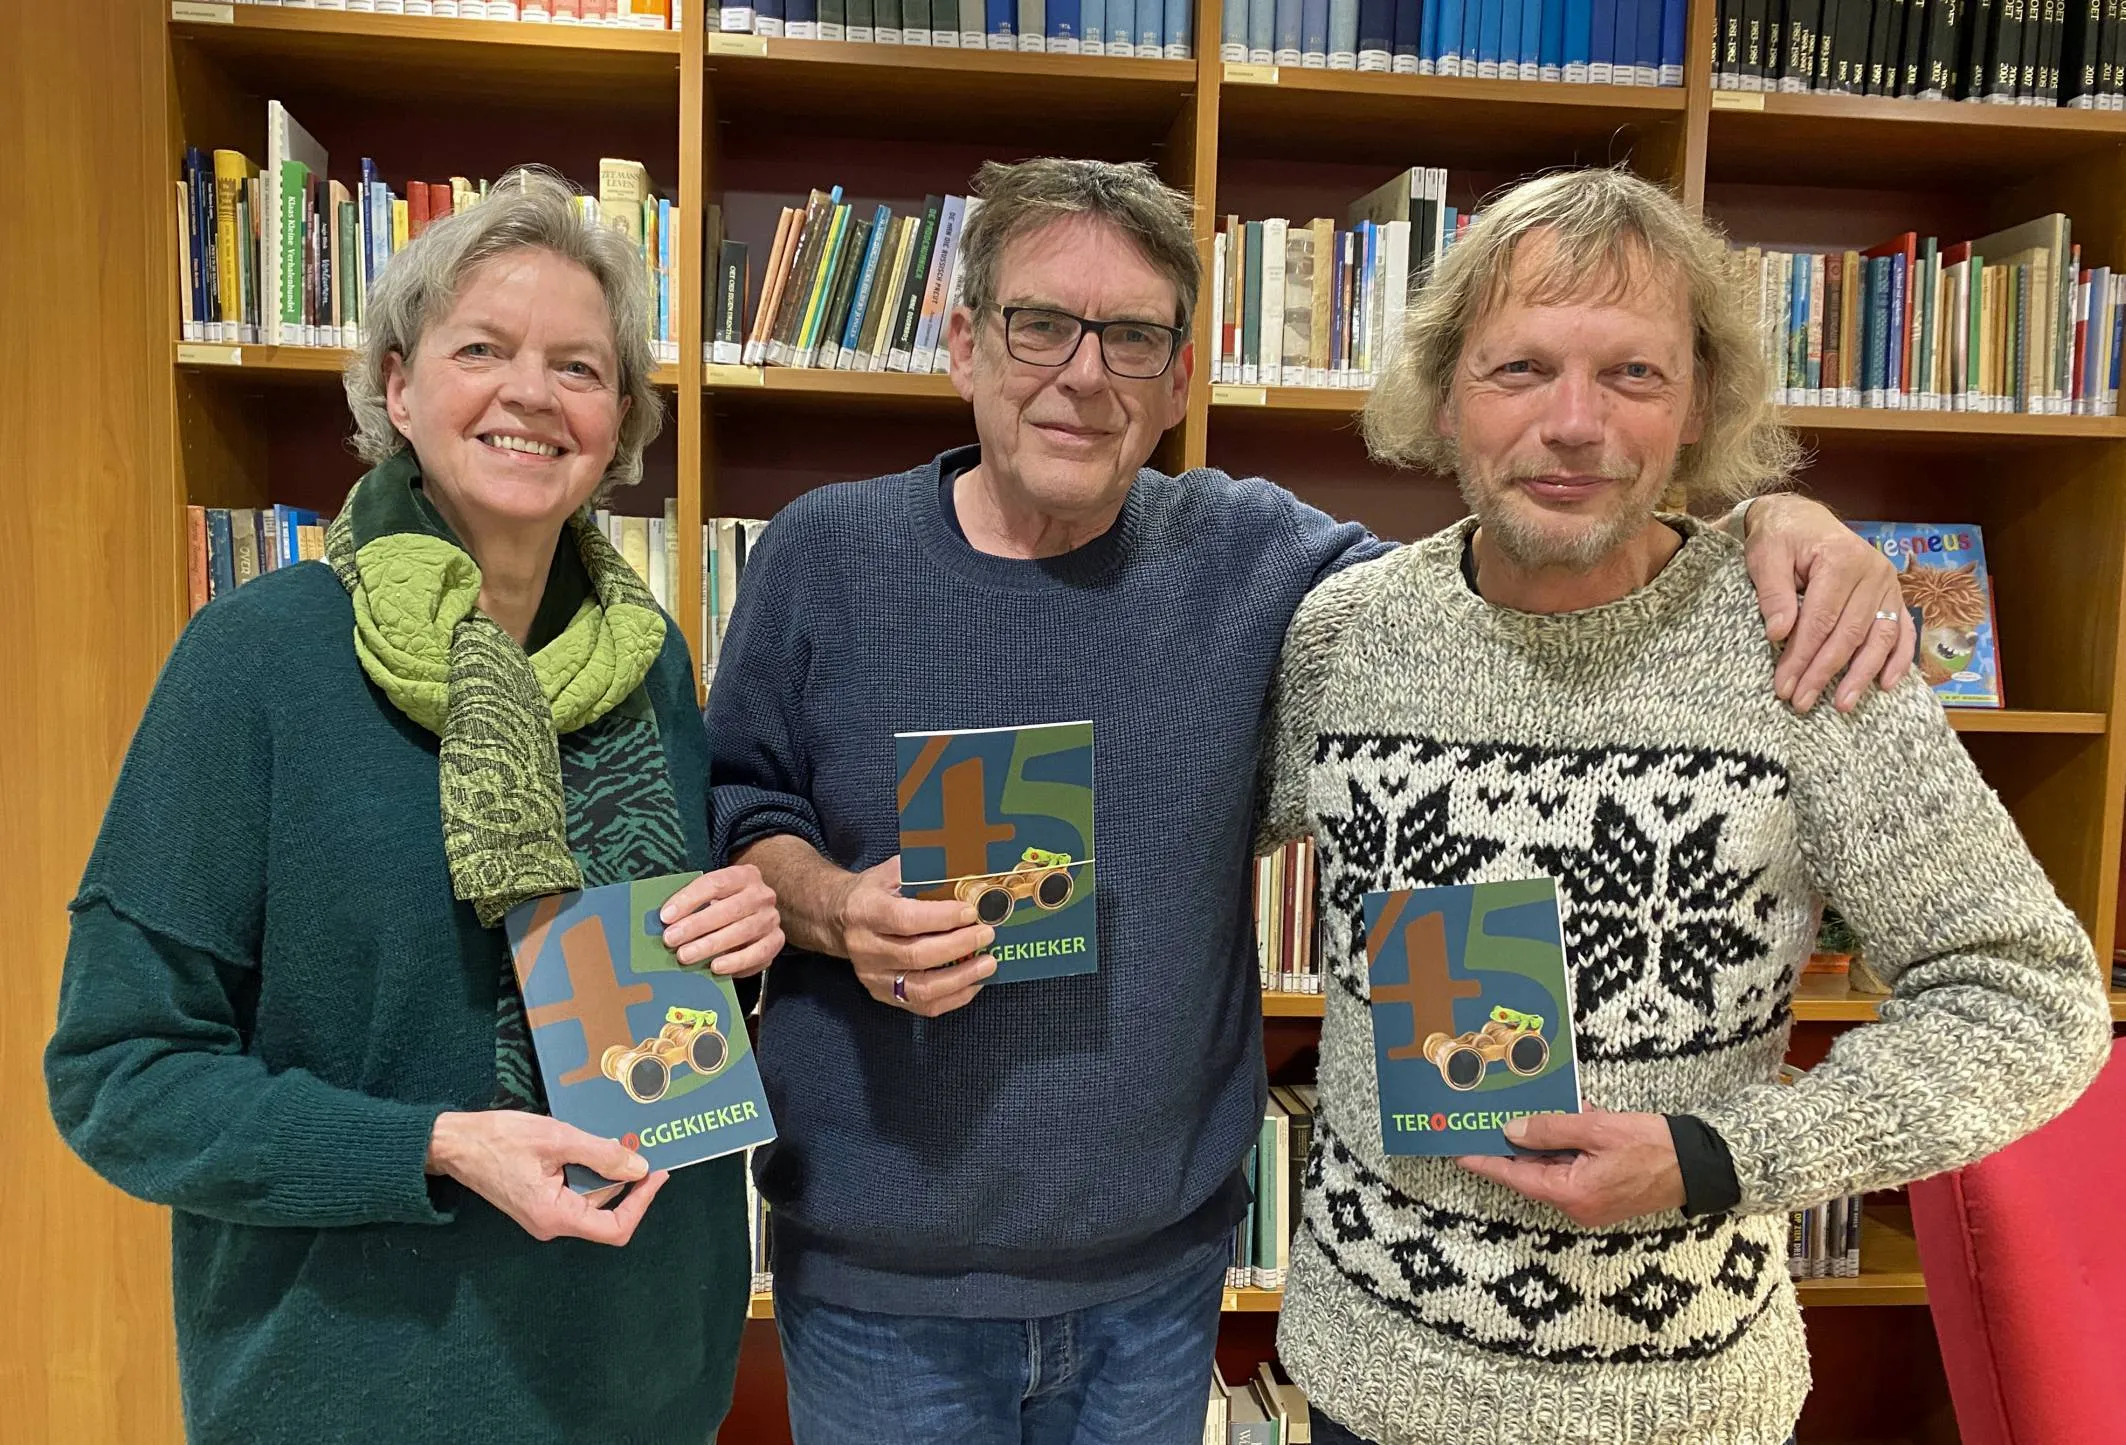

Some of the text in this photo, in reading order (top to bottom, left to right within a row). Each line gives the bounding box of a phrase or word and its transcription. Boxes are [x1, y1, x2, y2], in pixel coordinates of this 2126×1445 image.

[2029, 0, 2039, 21] OET
[2045, 0, 2054, 22] OET
[2056, 0, 2065, 24] OET
[2091, 0, 2100, 21] OET
[2024, 65, 2034, 87] 2007
[2085, 64, 2095, 85] 2010
[606, 179, 634, 188] LEVEN
[949, 211, 956, 220] DE
[288, 196, 296, 313] Klaas Kleine Verhalenbundel
[936, 248, 948, 281] RUSSISCH
[1868, 532, 1972, 558] iesneus
[239, 547, 251, 575] OVER
[957, 936, 1086, 964] GEKIEKER
[609, 1100, 759, 1153] OGGEKIEKER
[1793, 1243, 1801, 1258] DRE
